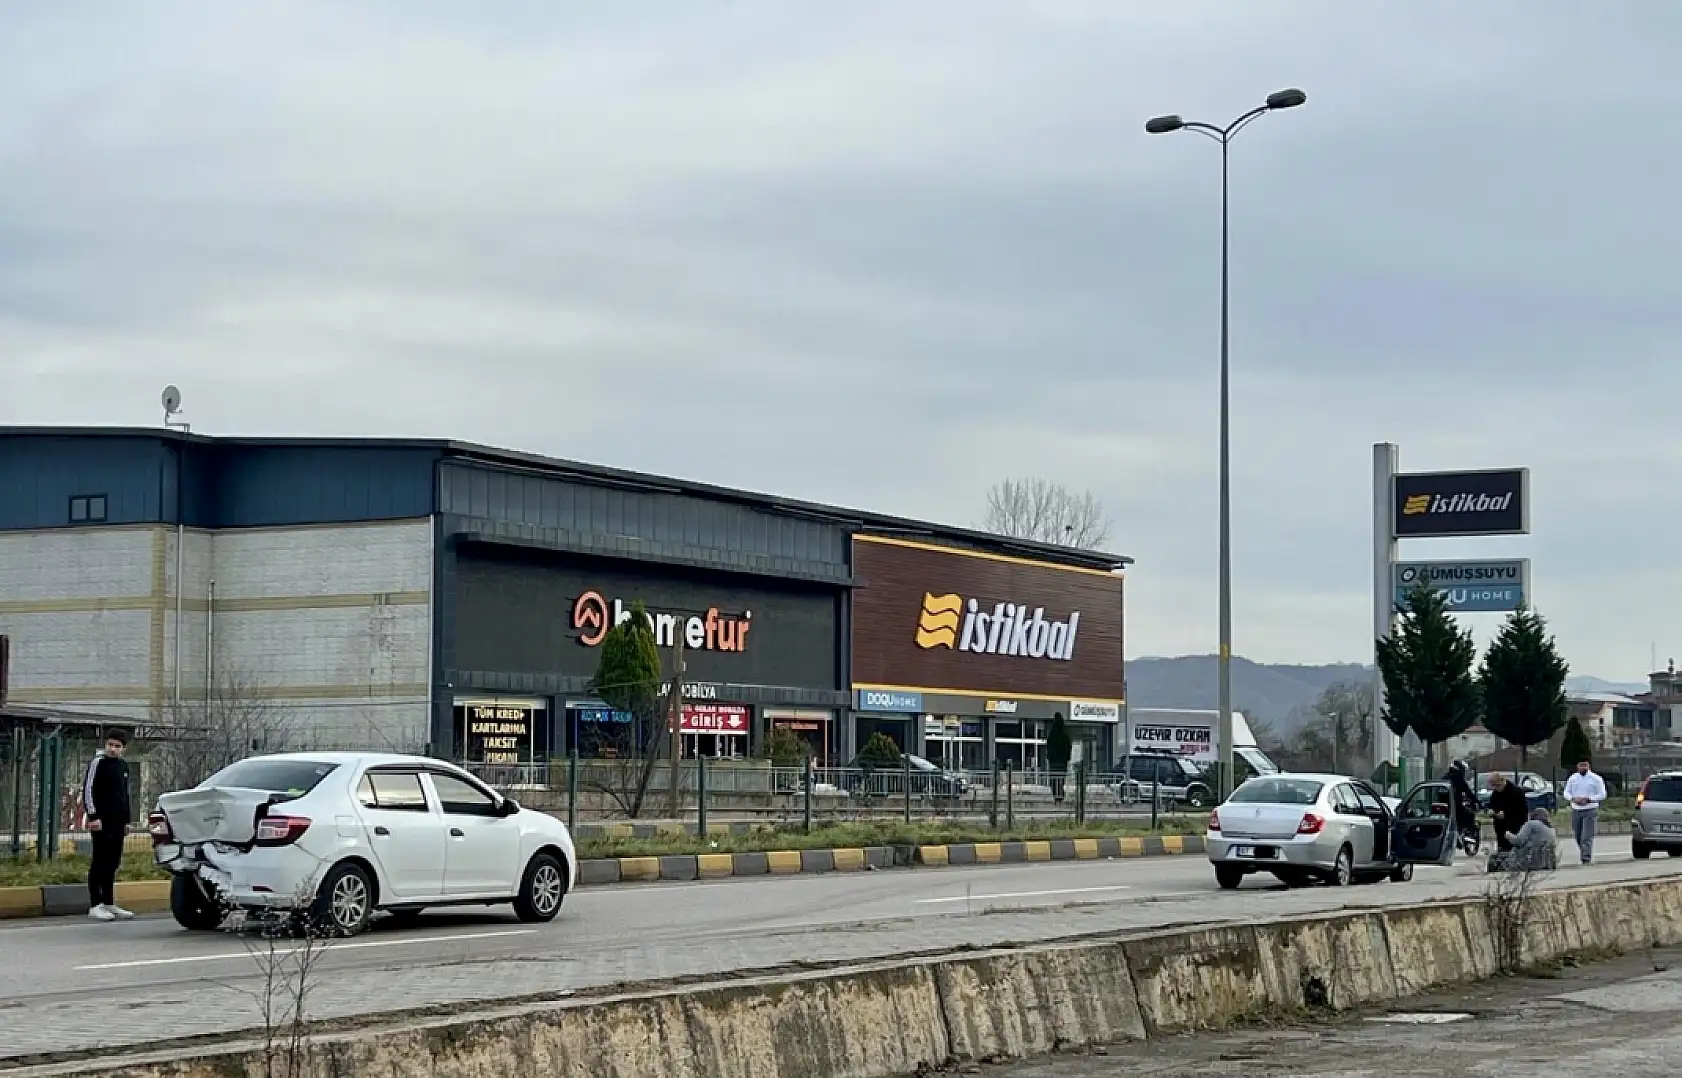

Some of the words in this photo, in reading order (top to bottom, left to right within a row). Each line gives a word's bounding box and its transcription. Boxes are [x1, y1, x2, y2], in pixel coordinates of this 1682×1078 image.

[1430, 491, 1513, 513] istikbal
[614, 598, 749, 652] hmefur
[959, 598, 1081, 661] istikbal
[691, 713, 724, 729] GİRİŞ
